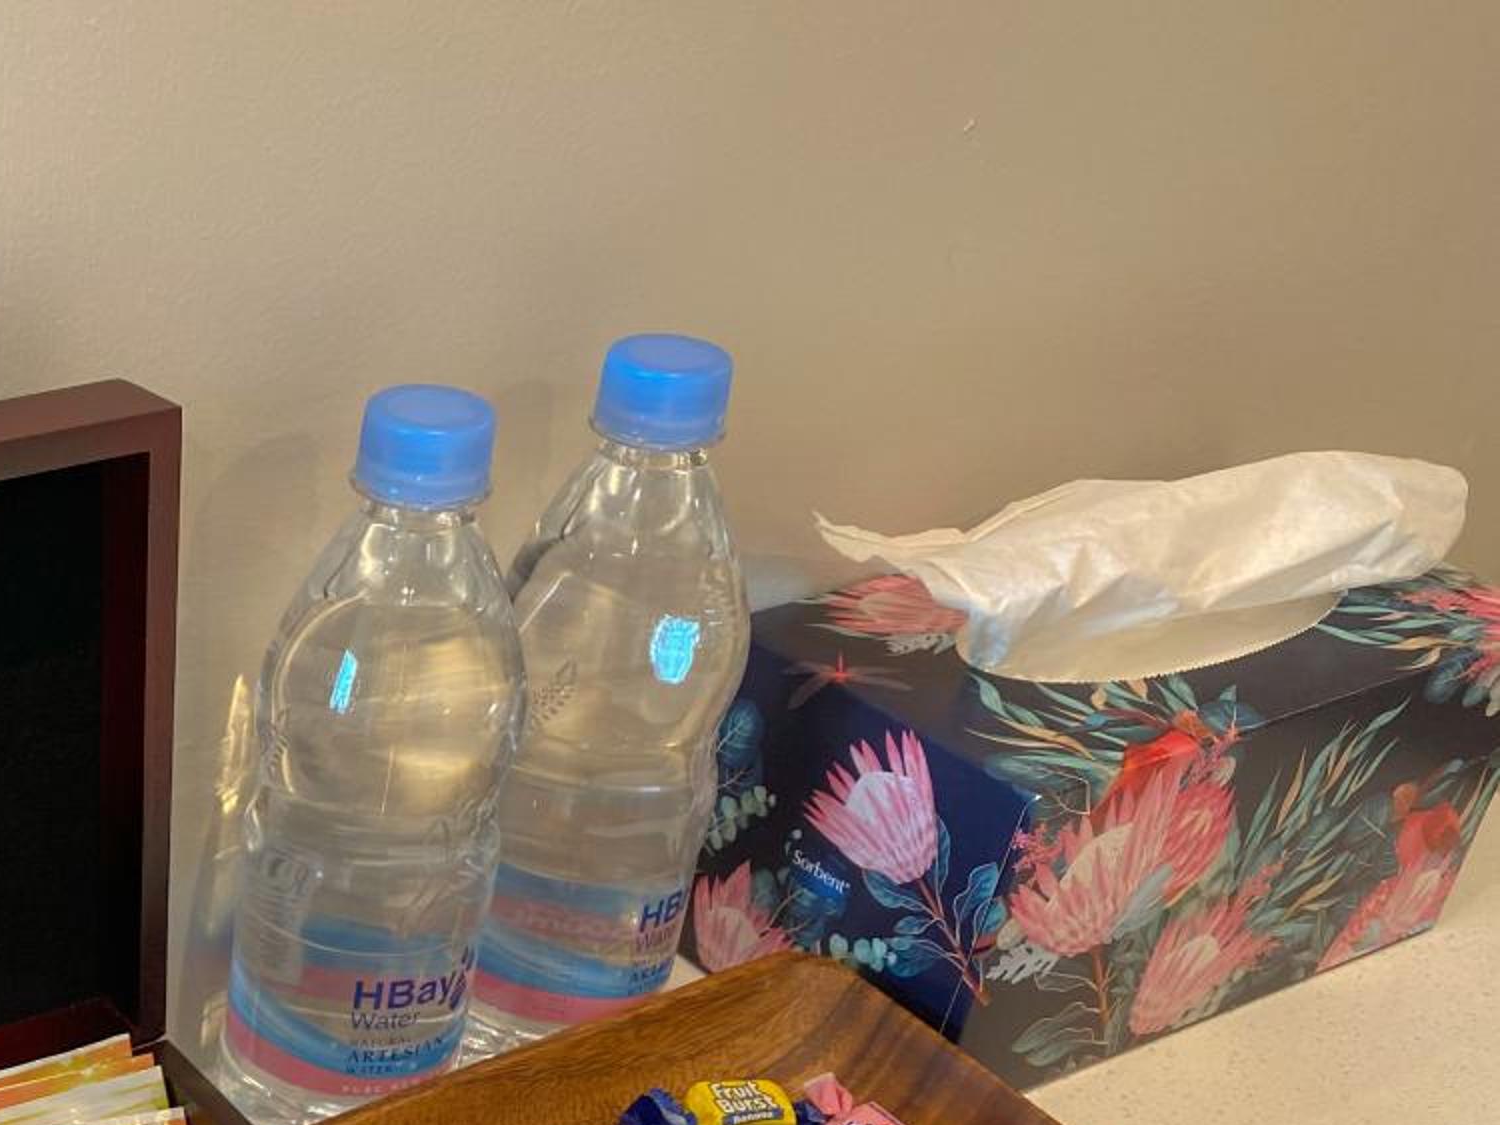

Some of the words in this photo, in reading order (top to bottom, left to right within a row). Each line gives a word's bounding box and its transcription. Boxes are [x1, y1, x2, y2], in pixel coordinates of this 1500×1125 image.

[792, 849, 847, 895] Sorbent
[345, 1035, 444, 1064] ARTESIAN
[711, 1080, 761, 1100] Fruit
[716, 1094, 778, 1114] Burst
